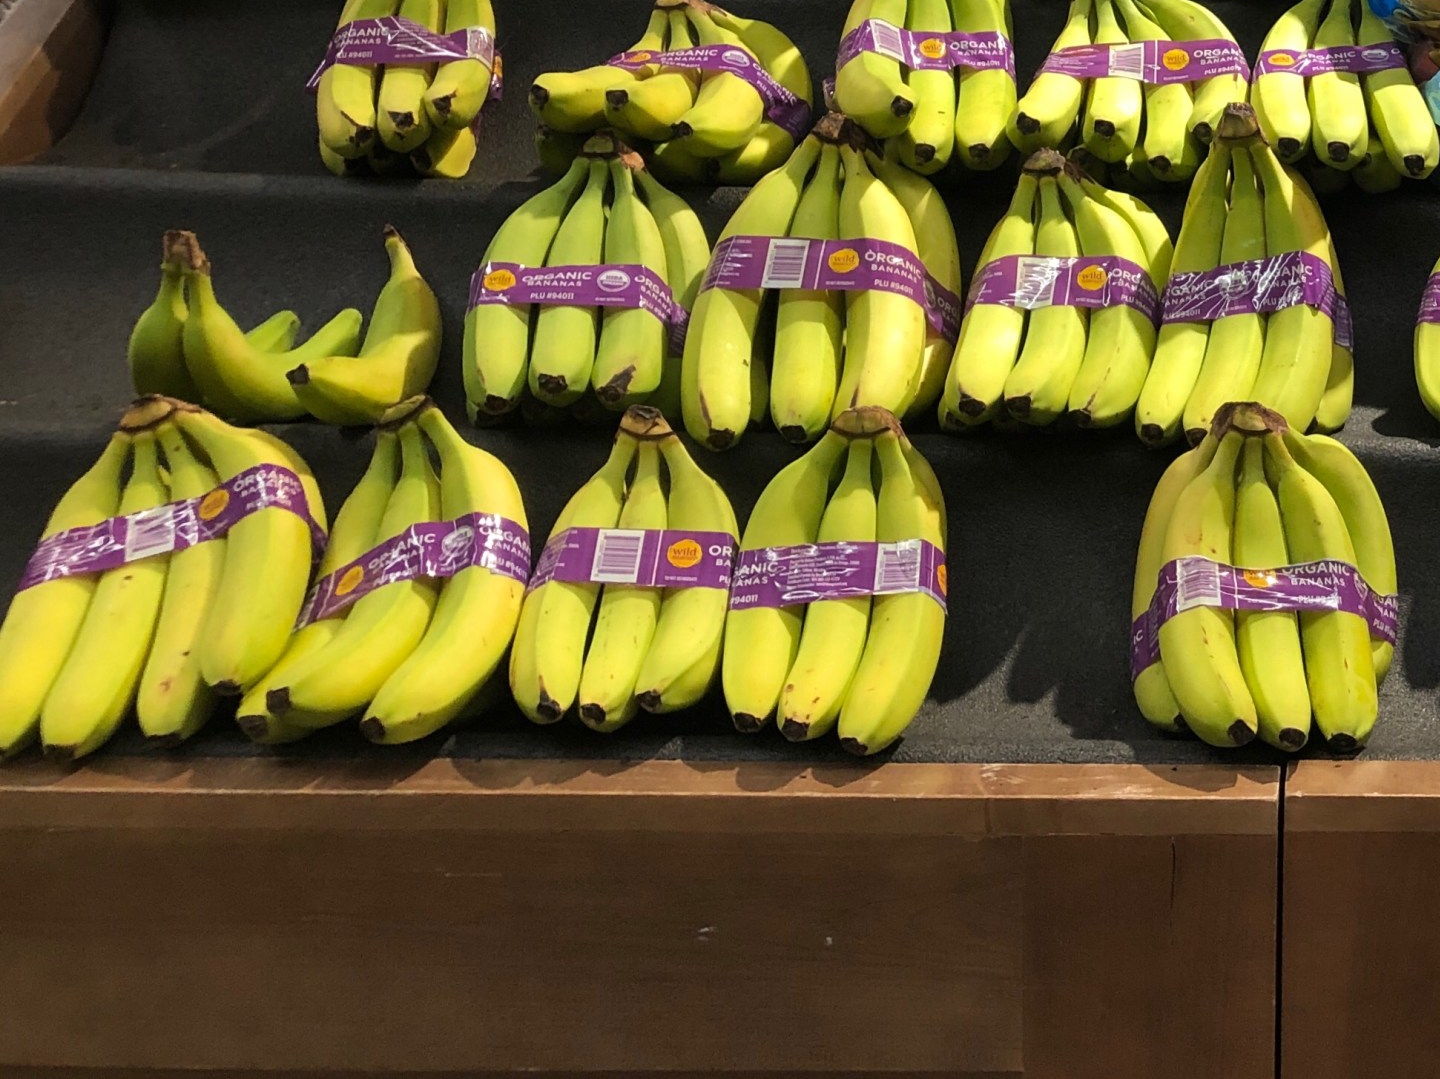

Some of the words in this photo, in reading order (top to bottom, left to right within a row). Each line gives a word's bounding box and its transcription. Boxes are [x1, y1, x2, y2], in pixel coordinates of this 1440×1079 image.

[334, 26, 389, 43] ORGANIC
[950, 41, 1006, 51] ORGANI
[658, 49, 718, 58] ORGANIC
[1194, 48, 1243, 58] ORGAN
[1168, 55, 1185, 63] wild
[752, 62, 798, 105] ORGANIC
[832, 254, 856, 263] wild
[864, 250, 922, 278] ORGANIC
[522, 272, 592, 282] ORGANIC
[871, 264, 918, 284] BANANAS
[1081, 272, 1102, 280] wild
[874, 279, 888, 289] PLU
[890, 282, 914, 296] #94011
[546, 292, 574, 300] #94011
[1120, 294, 1134, 303] PLU
[672, 548, 697, 556] wild
[1282, 561, 1351, 576] ORGANIC
[1290, 577, 1346, 586] BANANAS
